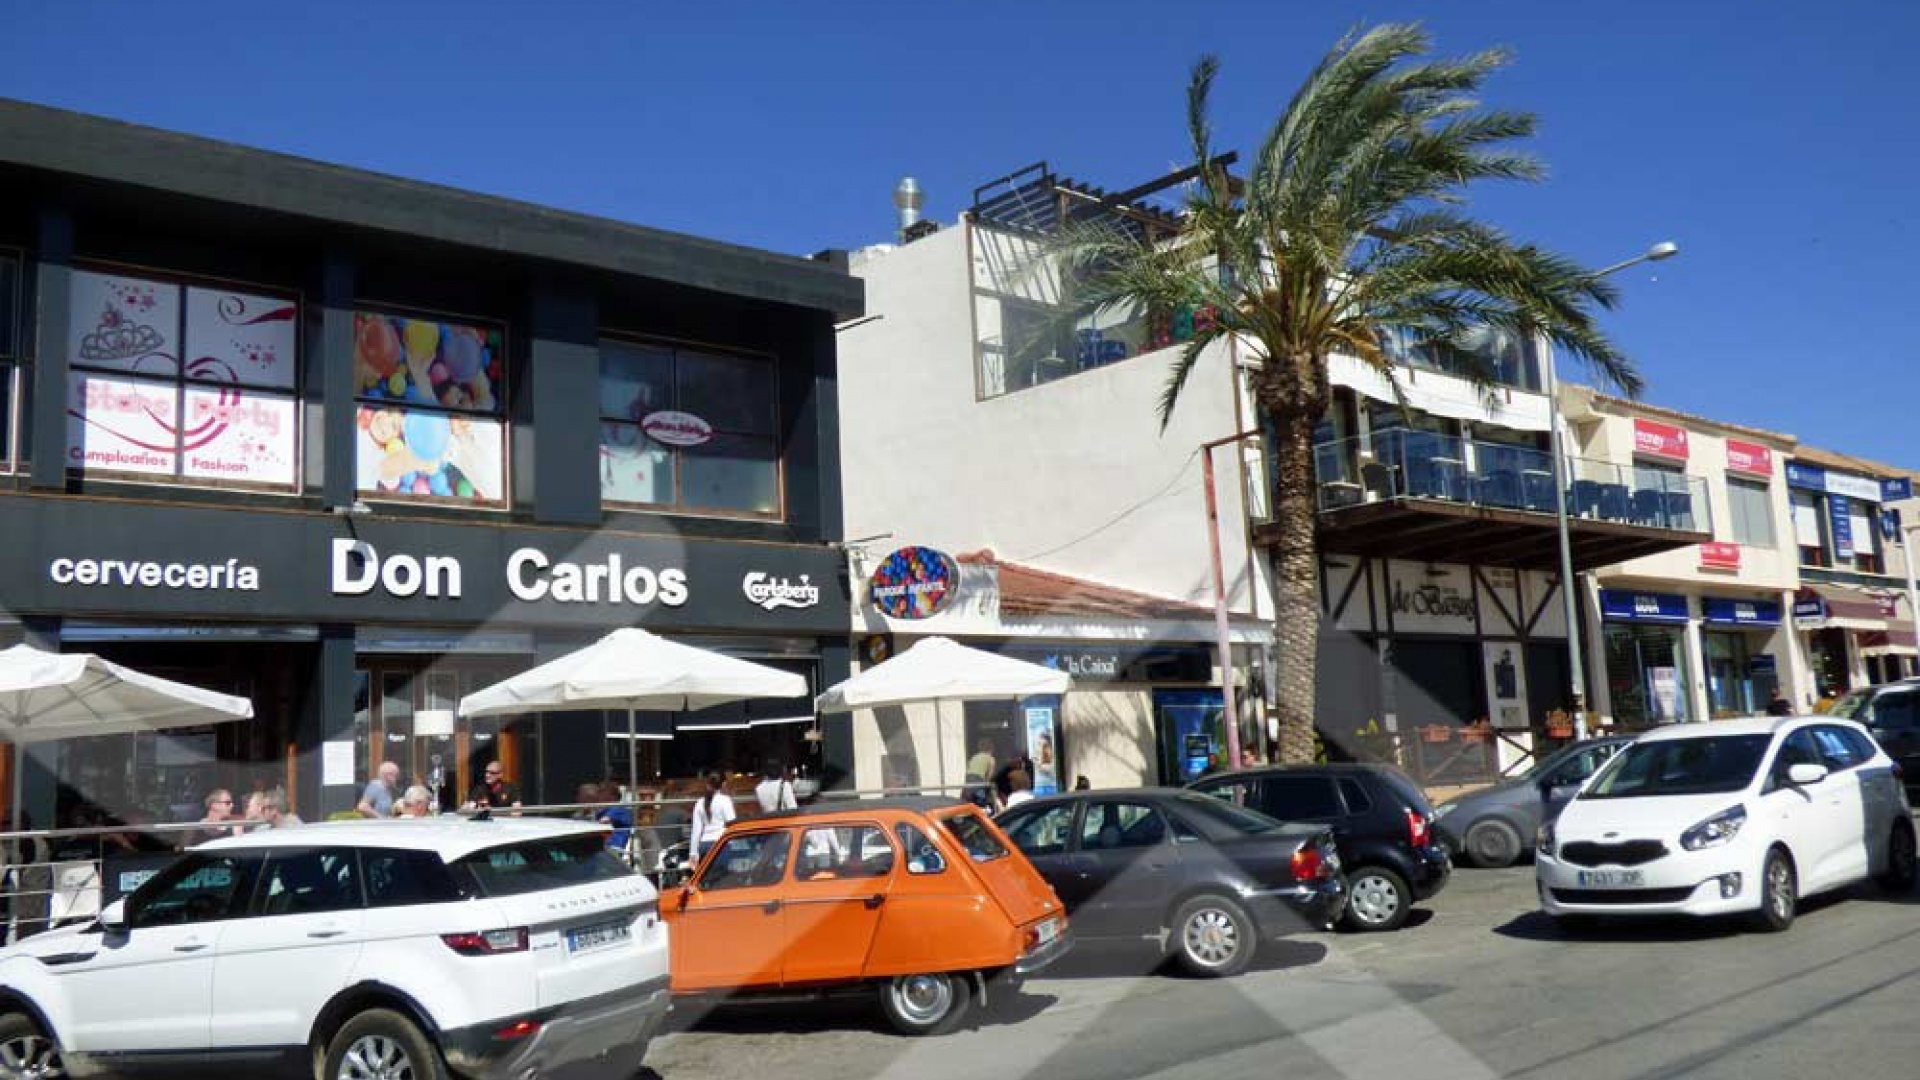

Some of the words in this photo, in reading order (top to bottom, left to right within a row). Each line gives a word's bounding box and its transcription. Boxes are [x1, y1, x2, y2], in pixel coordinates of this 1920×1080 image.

[51, 557, 260, 591] cervecería
[331, 536, 462, 598] Don
[506, 547, 688, 605] Carlos
[743, 572, 819, 610] Carlsberg
